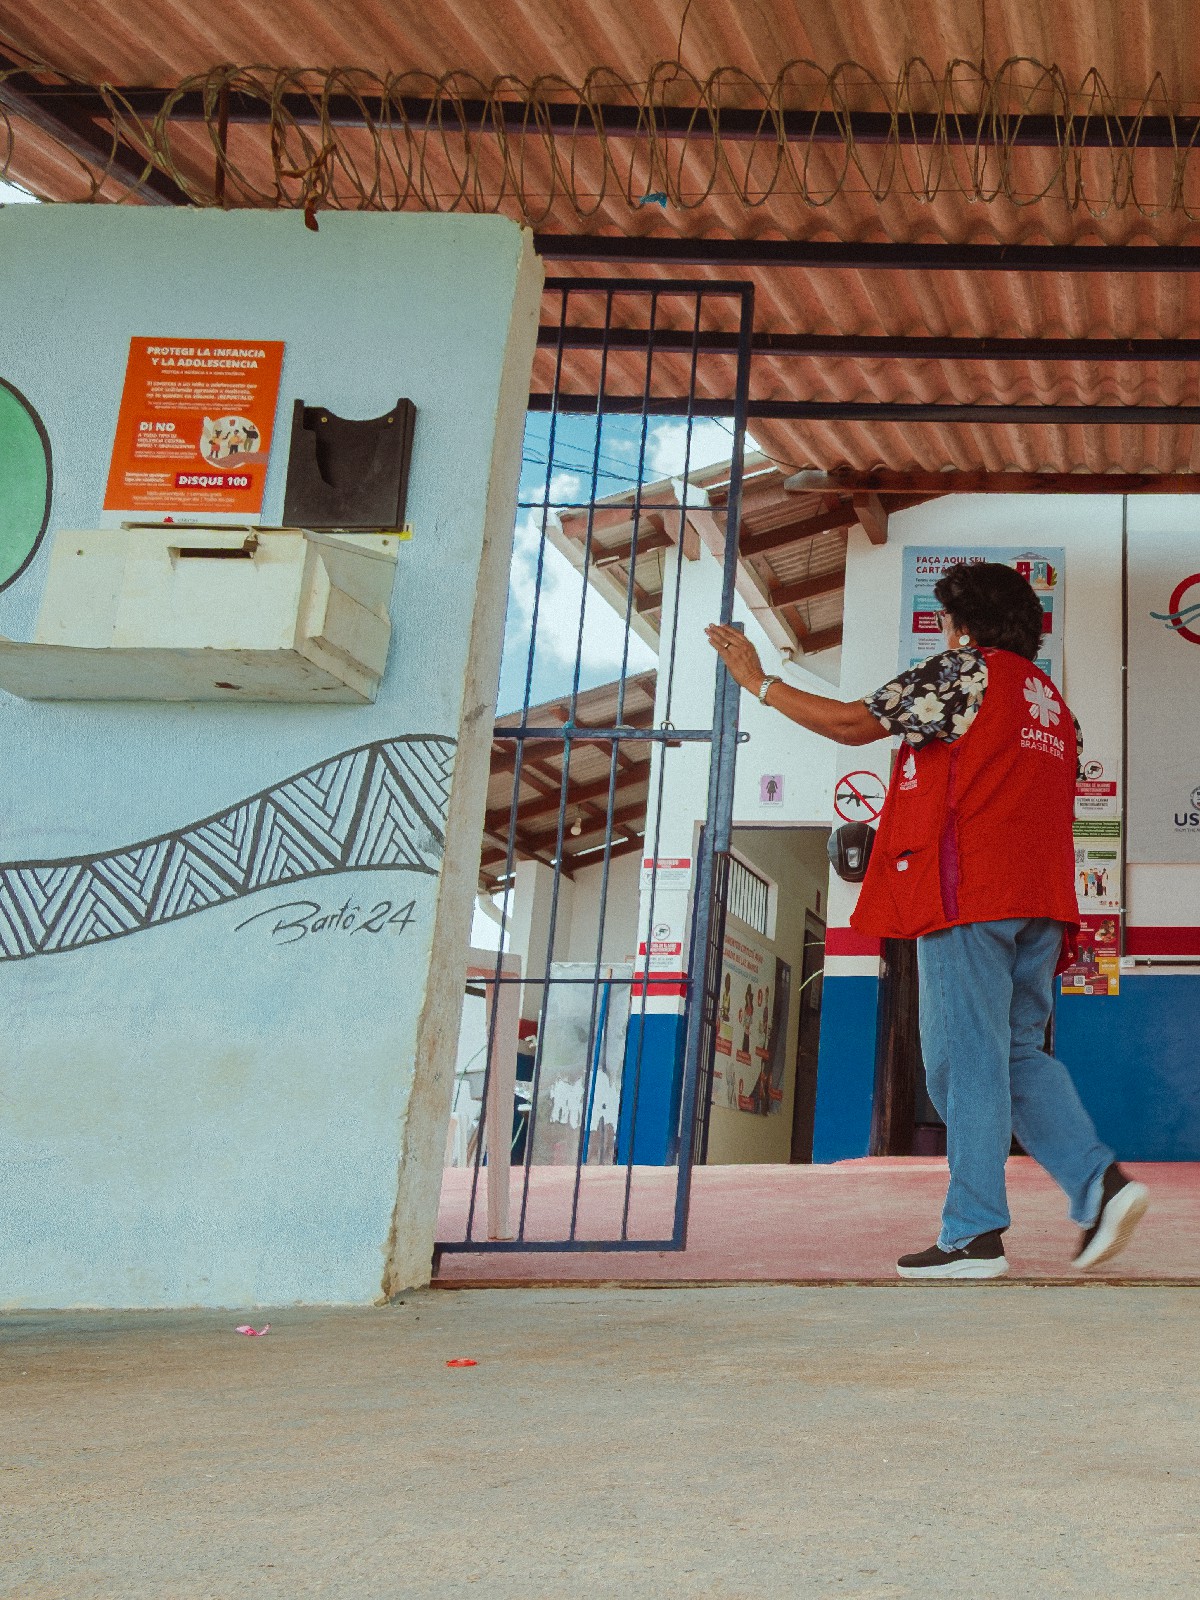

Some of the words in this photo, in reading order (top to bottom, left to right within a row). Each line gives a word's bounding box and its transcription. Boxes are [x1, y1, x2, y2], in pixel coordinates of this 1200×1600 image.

[146, 346, 195, 356] PROTEGE
[197, 347, 211, 357] LA
[151, 357, 160, 366] Y
[161, 358, 175, 366] LA
[177, 358, 258, 369] ADOLESCENCIA
[140, 421, 153, 431] DI
[156, 422, 176, 432] NO
[227, 476, 248, 487] 100
[916, 556, 941, 565] FAÇA
[943, 556, 967, 564] AQUI
[916, 565, 947, 574] CARTÃ
